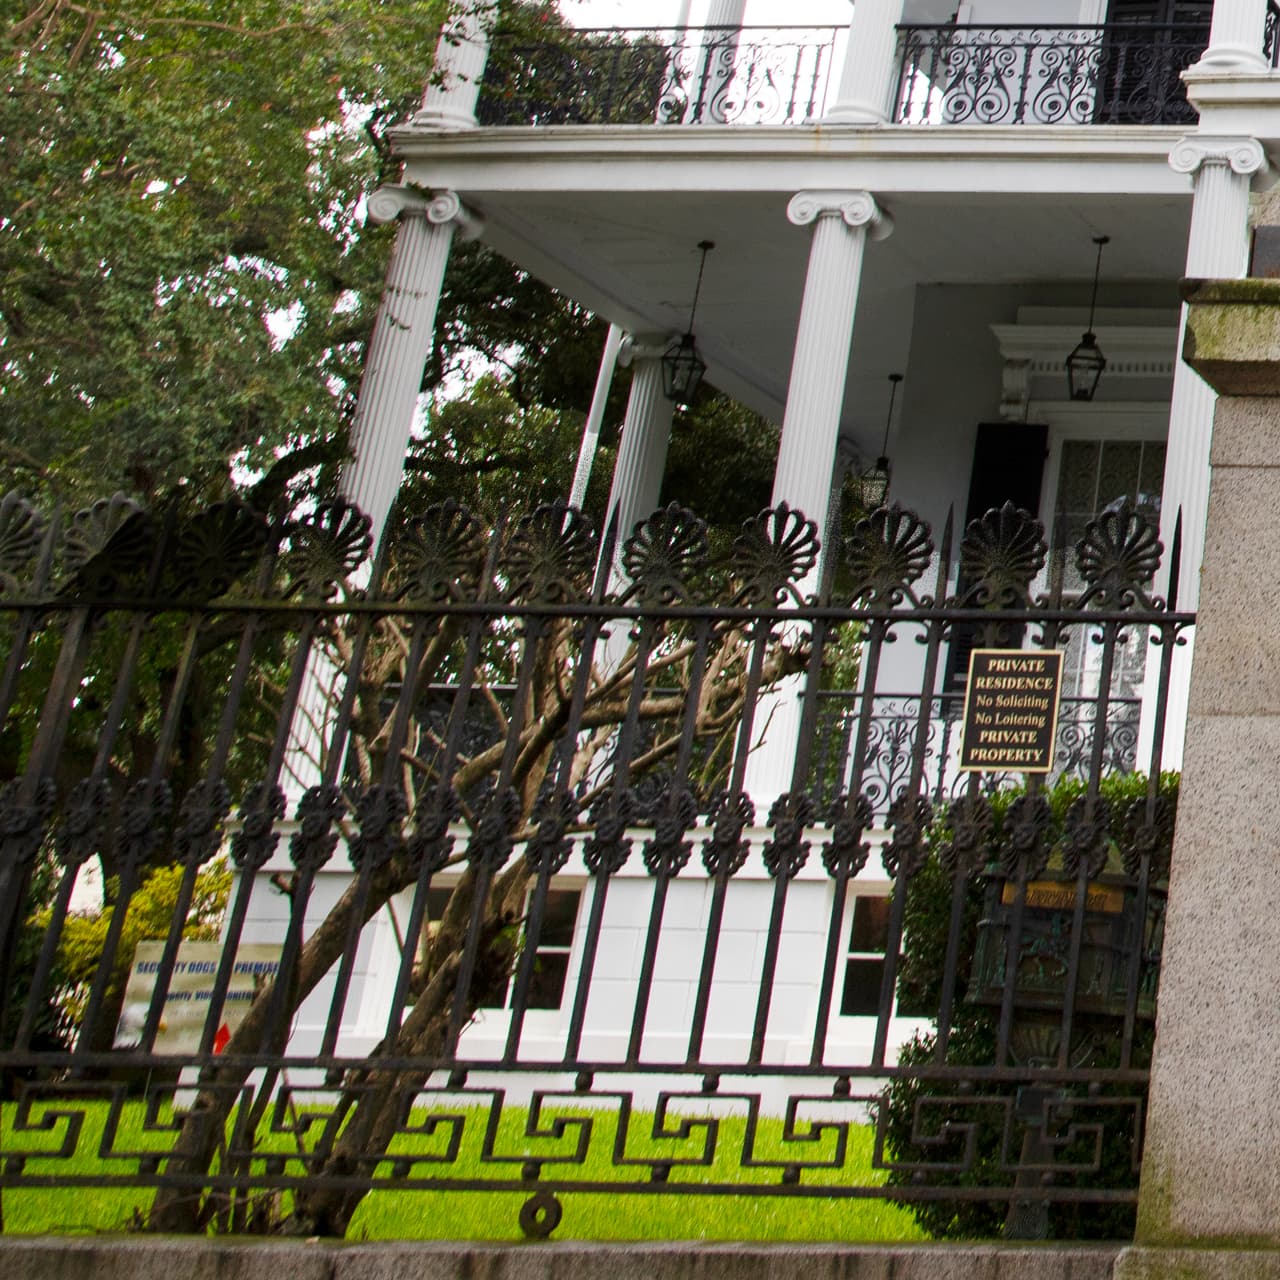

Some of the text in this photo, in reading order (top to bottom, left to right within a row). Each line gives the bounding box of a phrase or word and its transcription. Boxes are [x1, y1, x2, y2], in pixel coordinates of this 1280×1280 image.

[988, 659, 1046, 672] PRIVATE
[975, 676, 1054, 690] RESIDENCE
[976, 693, 1049, 711] No Soliciting
[975, 712, 1047, 728] No Loitering
[979, 730, 1038, 743] PRIVATE
[969, 748, 1044, 762] PROPERTY
[136, 960, 187, 974] SECUTY
[234, 960, 280, 974] PREMISE
